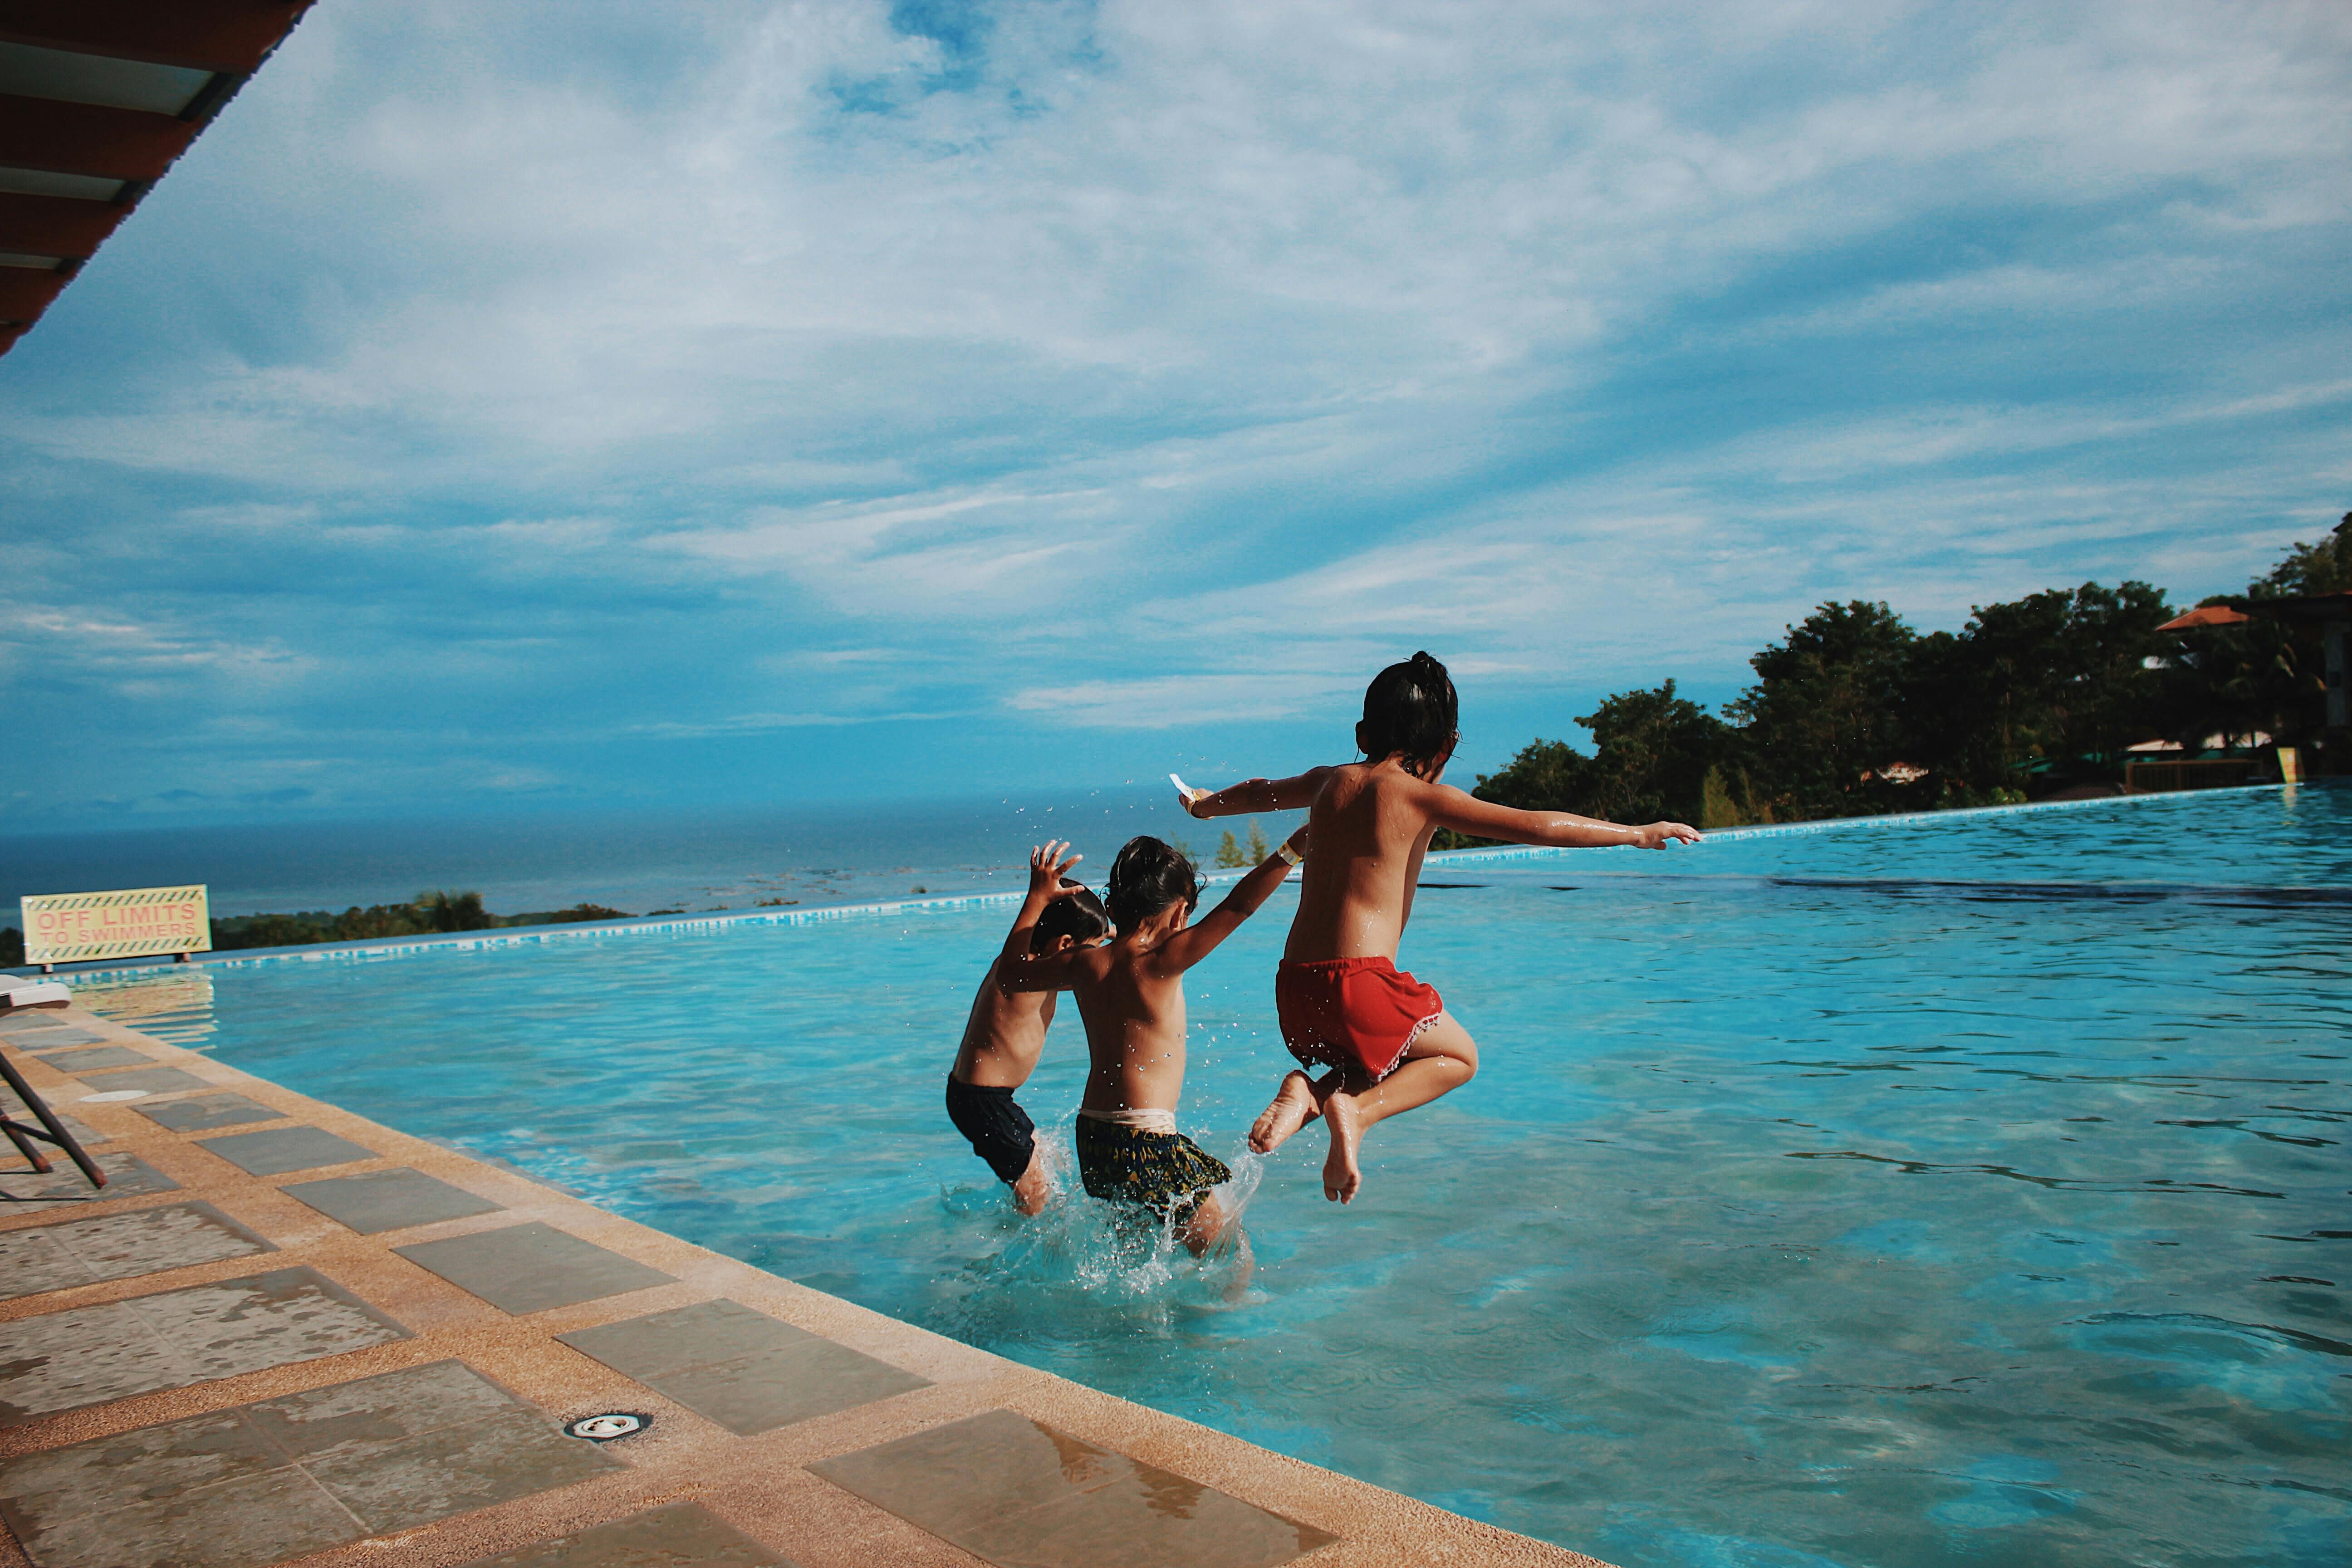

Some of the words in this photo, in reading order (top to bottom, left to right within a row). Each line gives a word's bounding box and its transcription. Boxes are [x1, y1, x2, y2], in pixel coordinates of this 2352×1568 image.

[38, 911, 91, 929] OFF
[103, 904, 196, 925] LIMITS
[39, 932, 69, 945] TO
[79, 923, 196, 942] SWIMMERS
